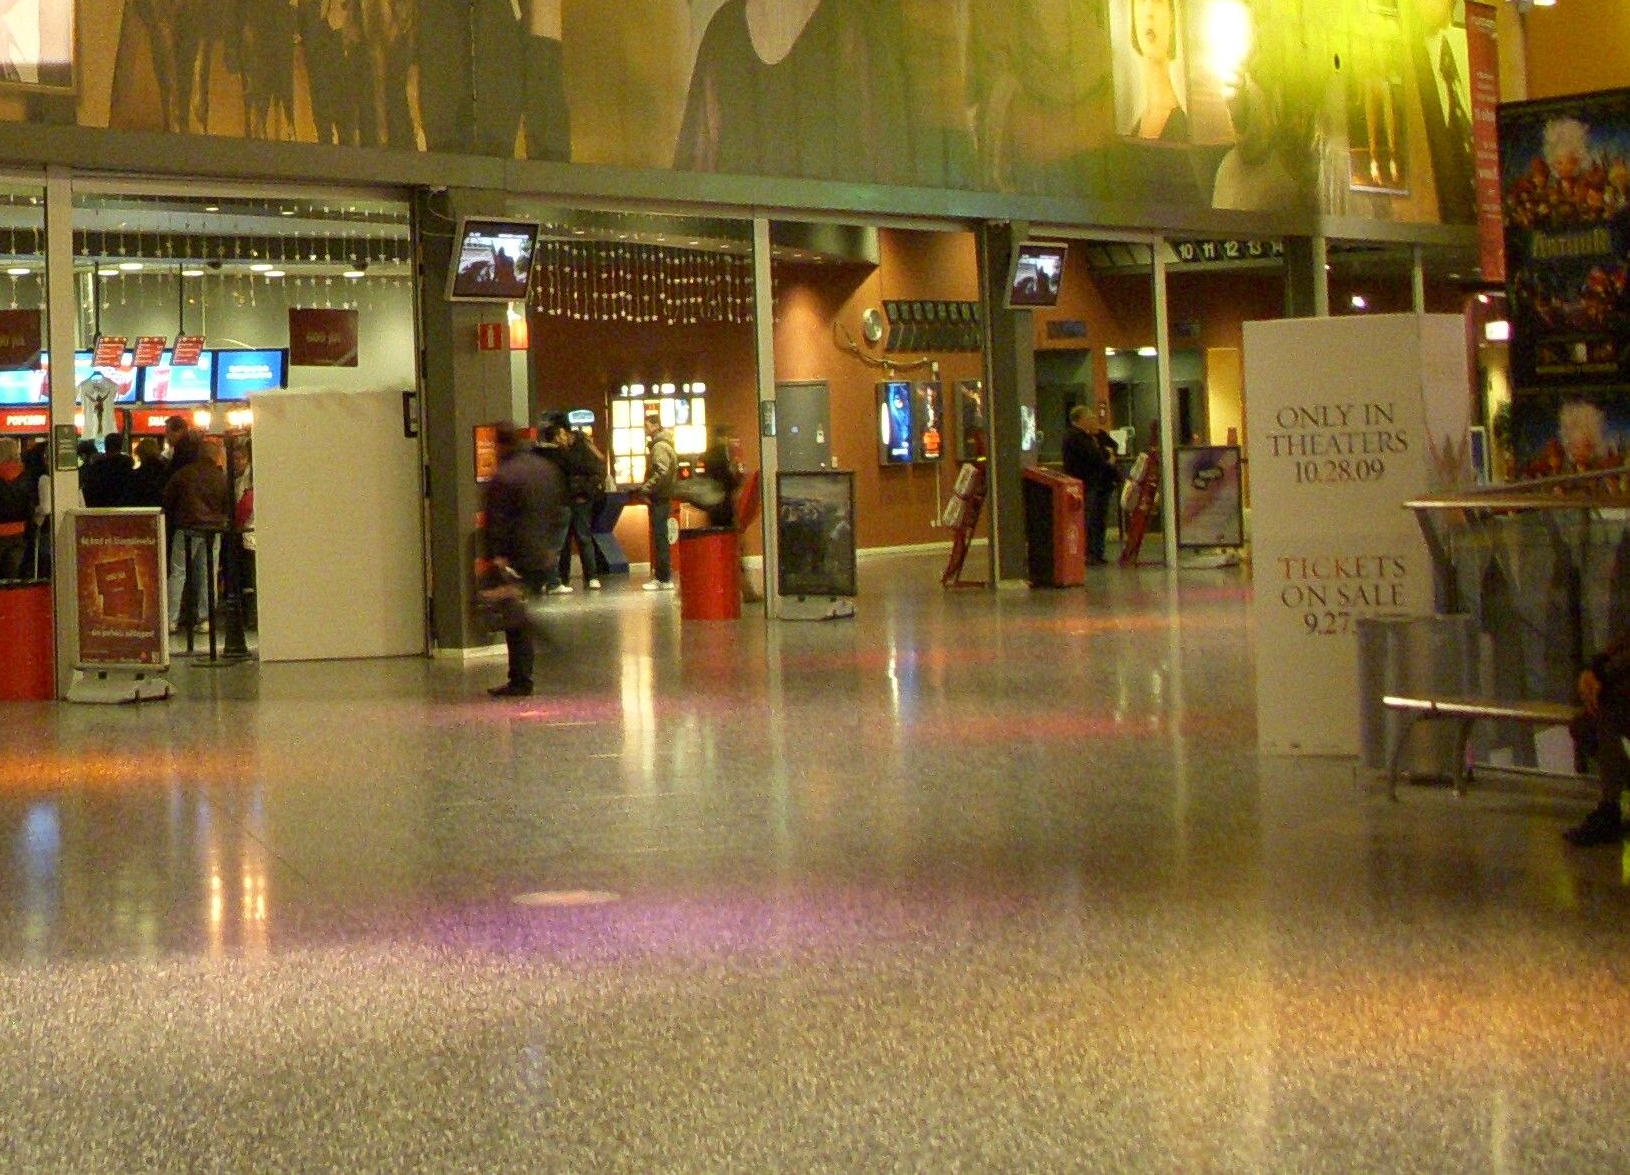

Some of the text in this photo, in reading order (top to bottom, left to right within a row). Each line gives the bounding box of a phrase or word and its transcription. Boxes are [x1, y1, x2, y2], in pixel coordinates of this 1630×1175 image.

[1179, 243, 1194, 260] 10
[1203, 242, 1216, 258] 11
[1224, 240, 1240, 257] 12
[1276, 402, 1394, 429] ONLY IN
[1266, 430, 1409, 457] THEATERS
[1294, 458, 1386, 485] 10.28.09
[1278, 556, 1406, 581] TICKETS
[1281, 582, 1405, 608] ON SALE
